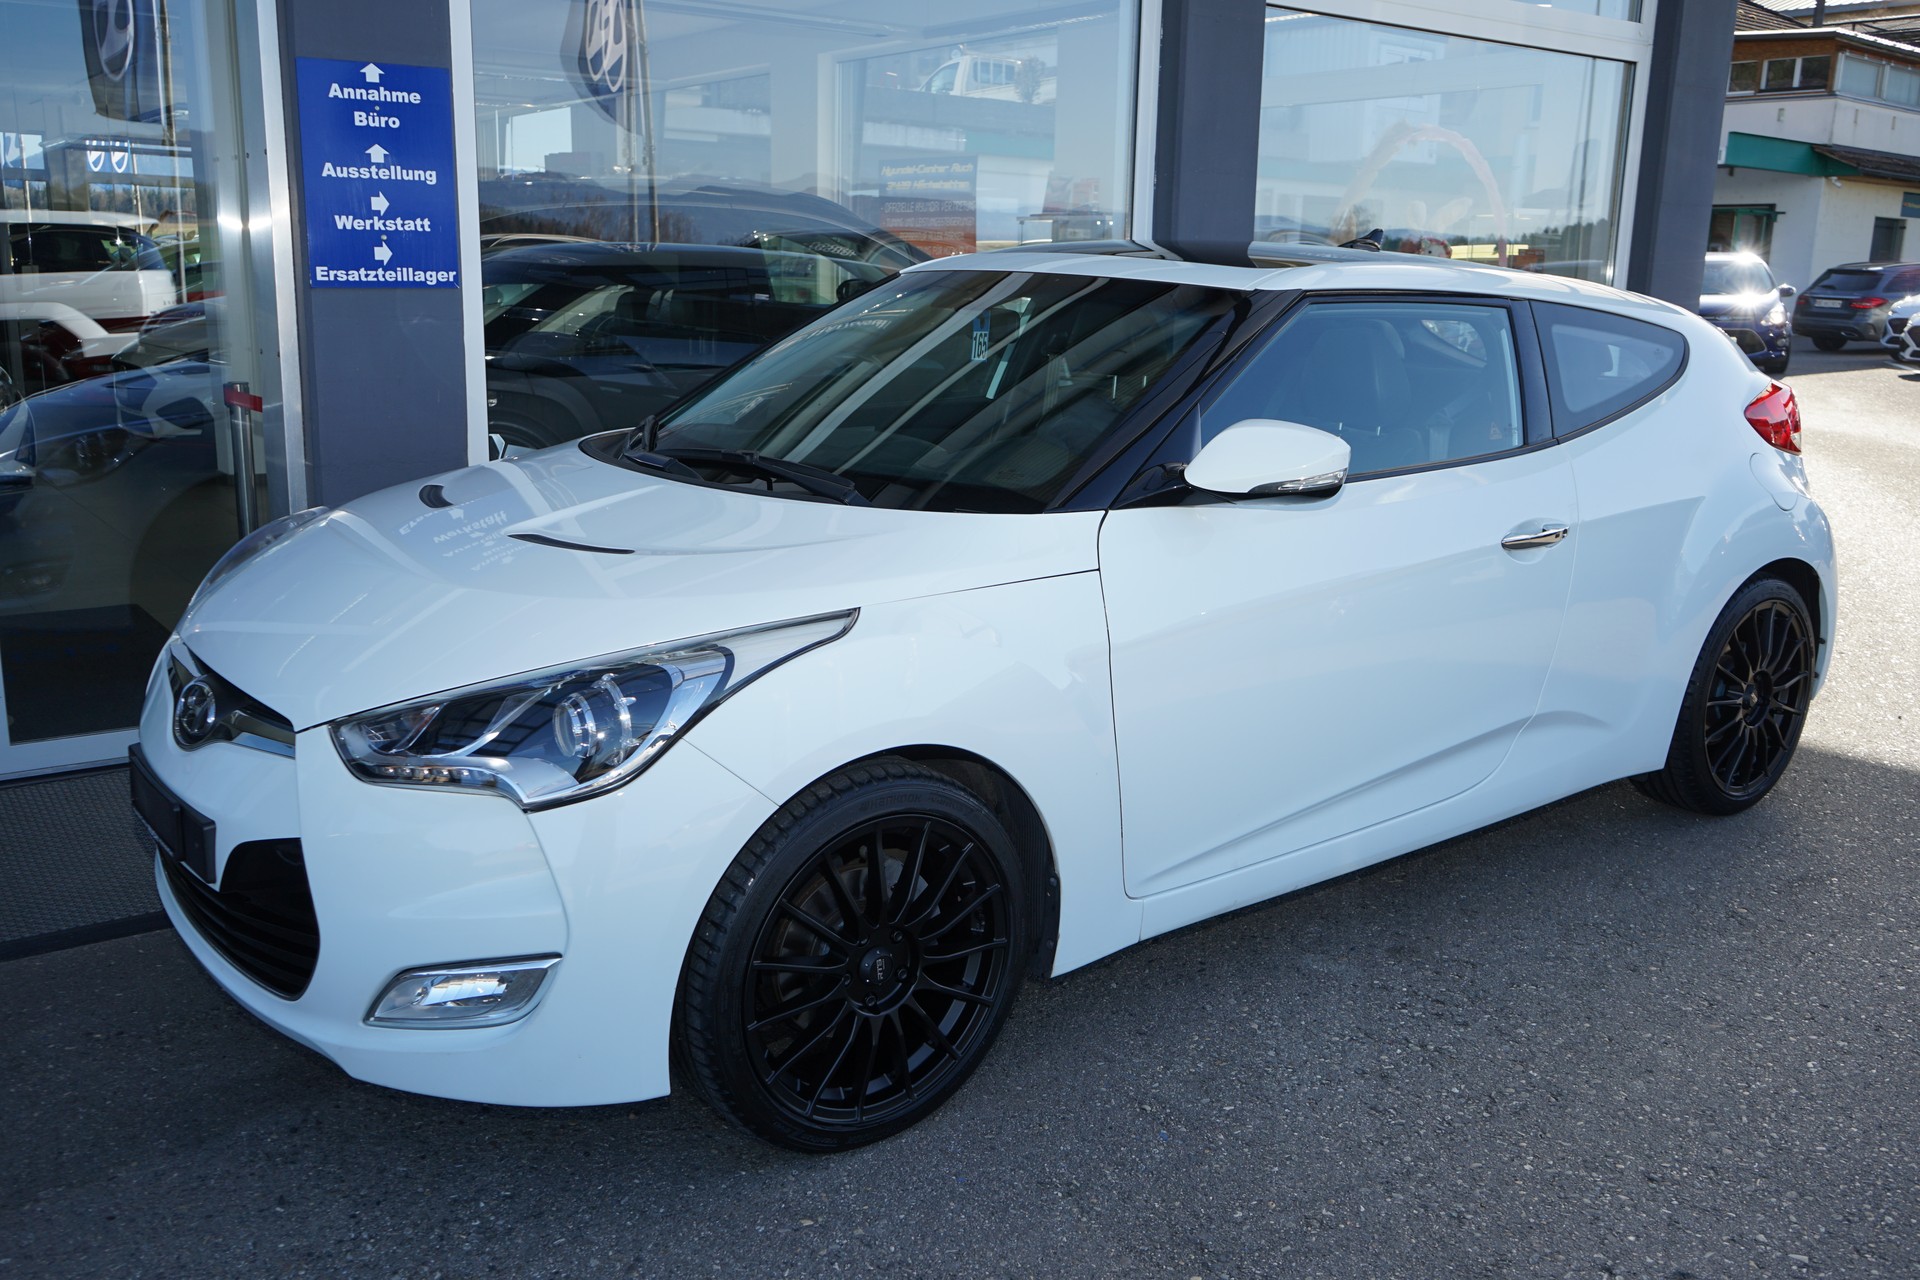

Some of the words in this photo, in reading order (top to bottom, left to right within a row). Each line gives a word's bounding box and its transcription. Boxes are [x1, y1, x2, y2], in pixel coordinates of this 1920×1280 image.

[328, 82, 421, 104] Annahme
[353, 111, 401, 128] Büro
[321, 162, 437, 185] Ausstellung
[334, 215, 431, 232] Werkstatt
[315, 266, 457, 285] Ersatzteillager
